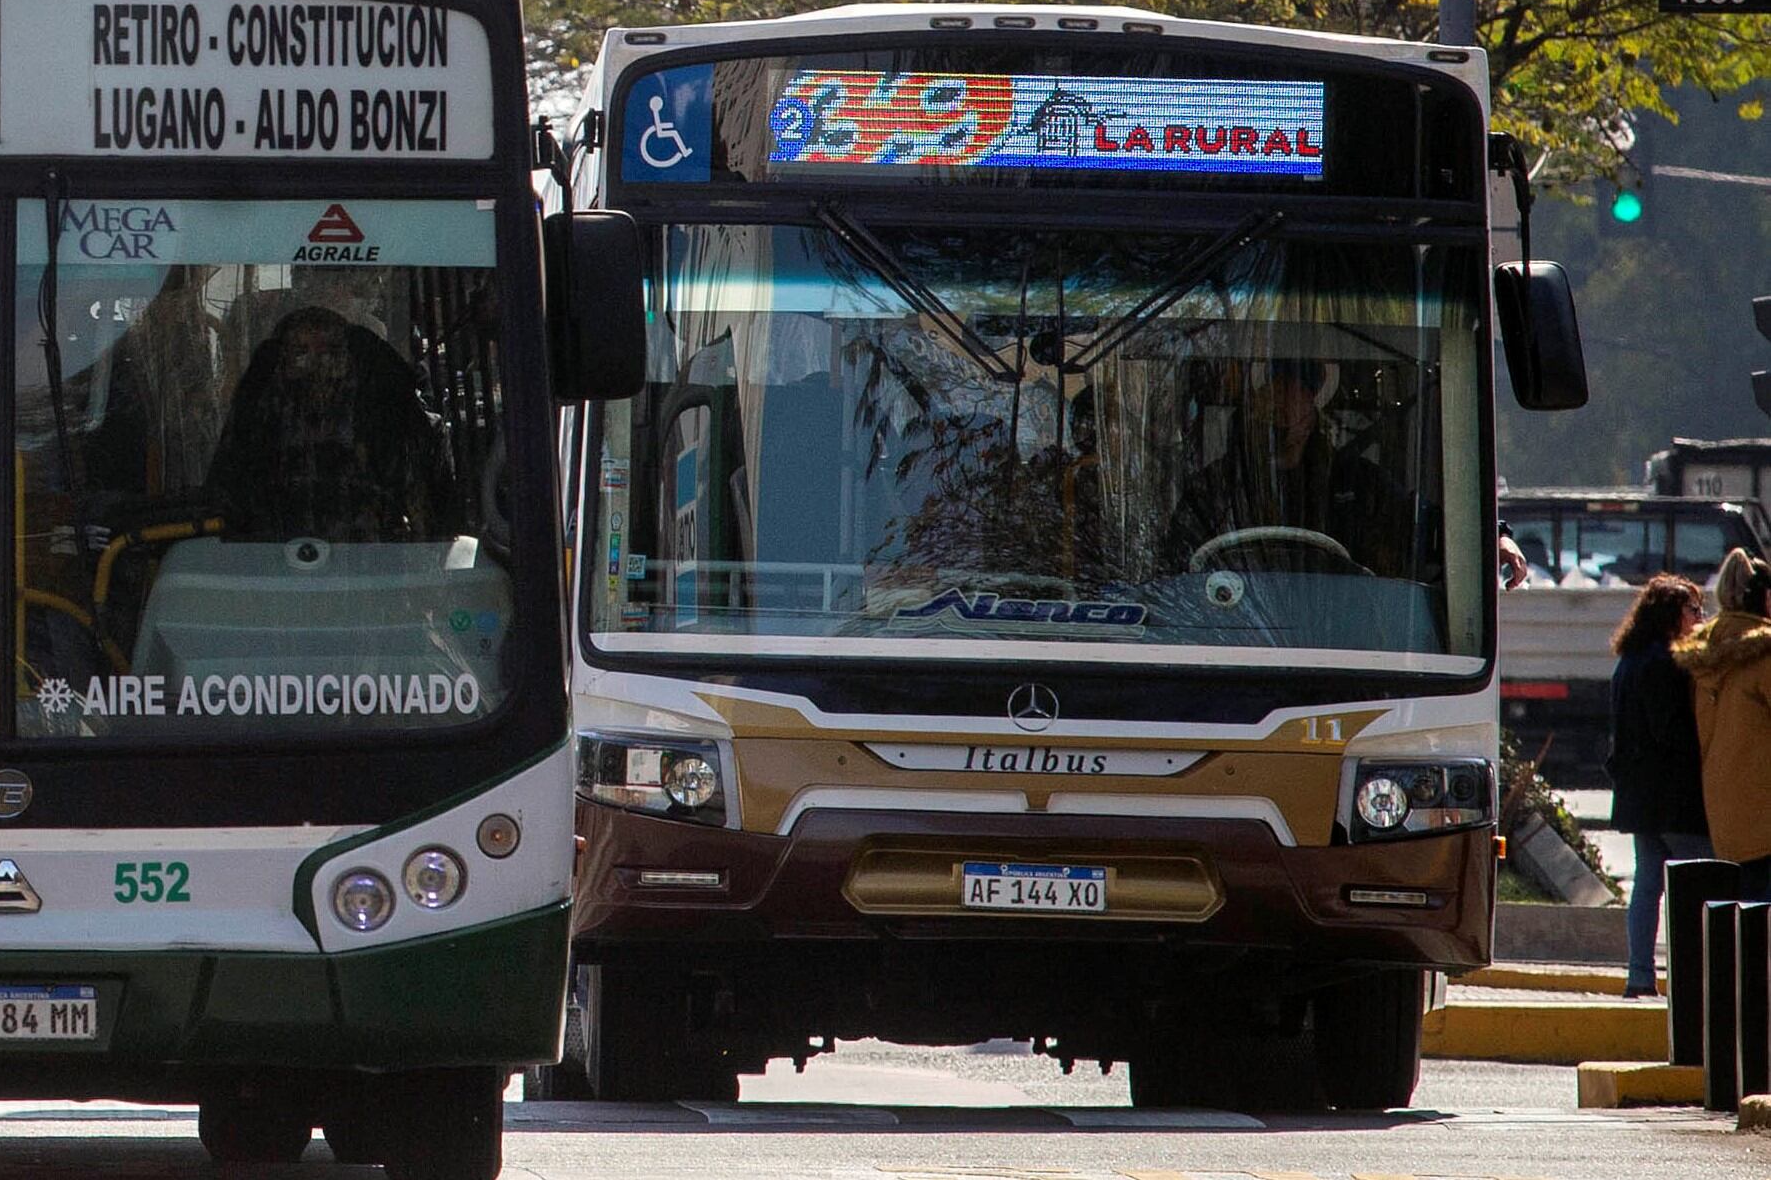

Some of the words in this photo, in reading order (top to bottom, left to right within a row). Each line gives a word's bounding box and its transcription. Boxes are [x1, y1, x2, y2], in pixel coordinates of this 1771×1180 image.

[94, 4, 200, 66] RETIRO
[94, 88, 225, 150] LUGANO
[255, 88, 339, 151] ALDO
[351, 90, 447, 151] BONZI
[781, 107, 803, 138] 2
[1095, 124, 1154, 153] LA
[1164, 124, 1323, 157] RURAL
[60, 203, 177, 233] MEGA
[80, 230, 160, 260] CAR
[292, 245, 381, 262] AGRALE
[83, 675, 166, 715] AIRE
[177, 673, 480, 716] ACONDICIONADO
[1301, 717, 1346, 746] 11
[964, 746, 1108, 774] Italbus
[114, 862, 191, 904] 552
[970, 878, 1001, 903] AF
[1011, 880, 1058, 905] 144
[50, 1003, 89, 1033] MM
